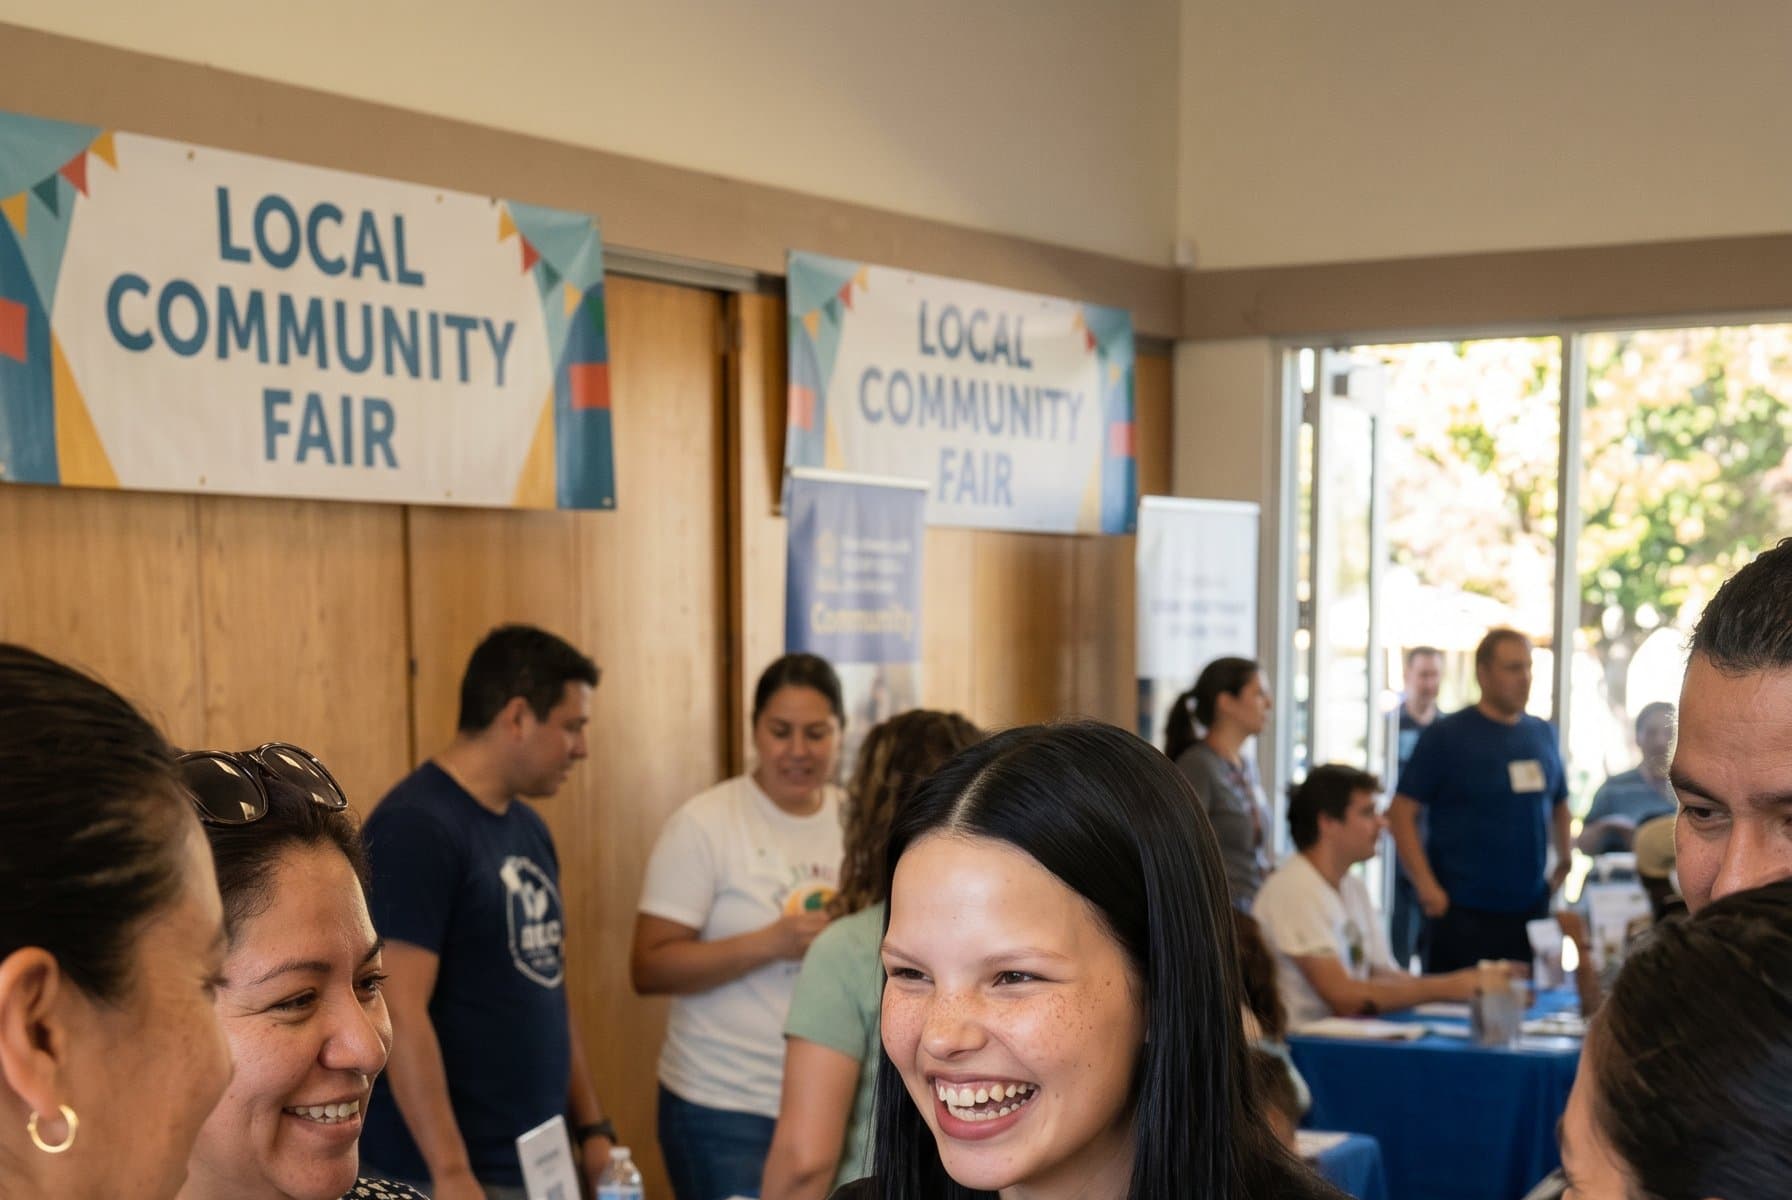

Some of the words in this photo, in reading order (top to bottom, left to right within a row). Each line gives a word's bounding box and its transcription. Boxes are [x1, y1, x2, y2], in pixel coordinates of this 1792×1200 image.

[216, 185, 425, 288] LOCAL
[105, 272, 517, 387] COMMUNITY
[917, 300, 1033, 371] LOCAL
[262, 387, 399, 469] FAIR
[858, 366, 1084, 442] COMMUNITY
[938, 448, 1015, 508] FAIR
